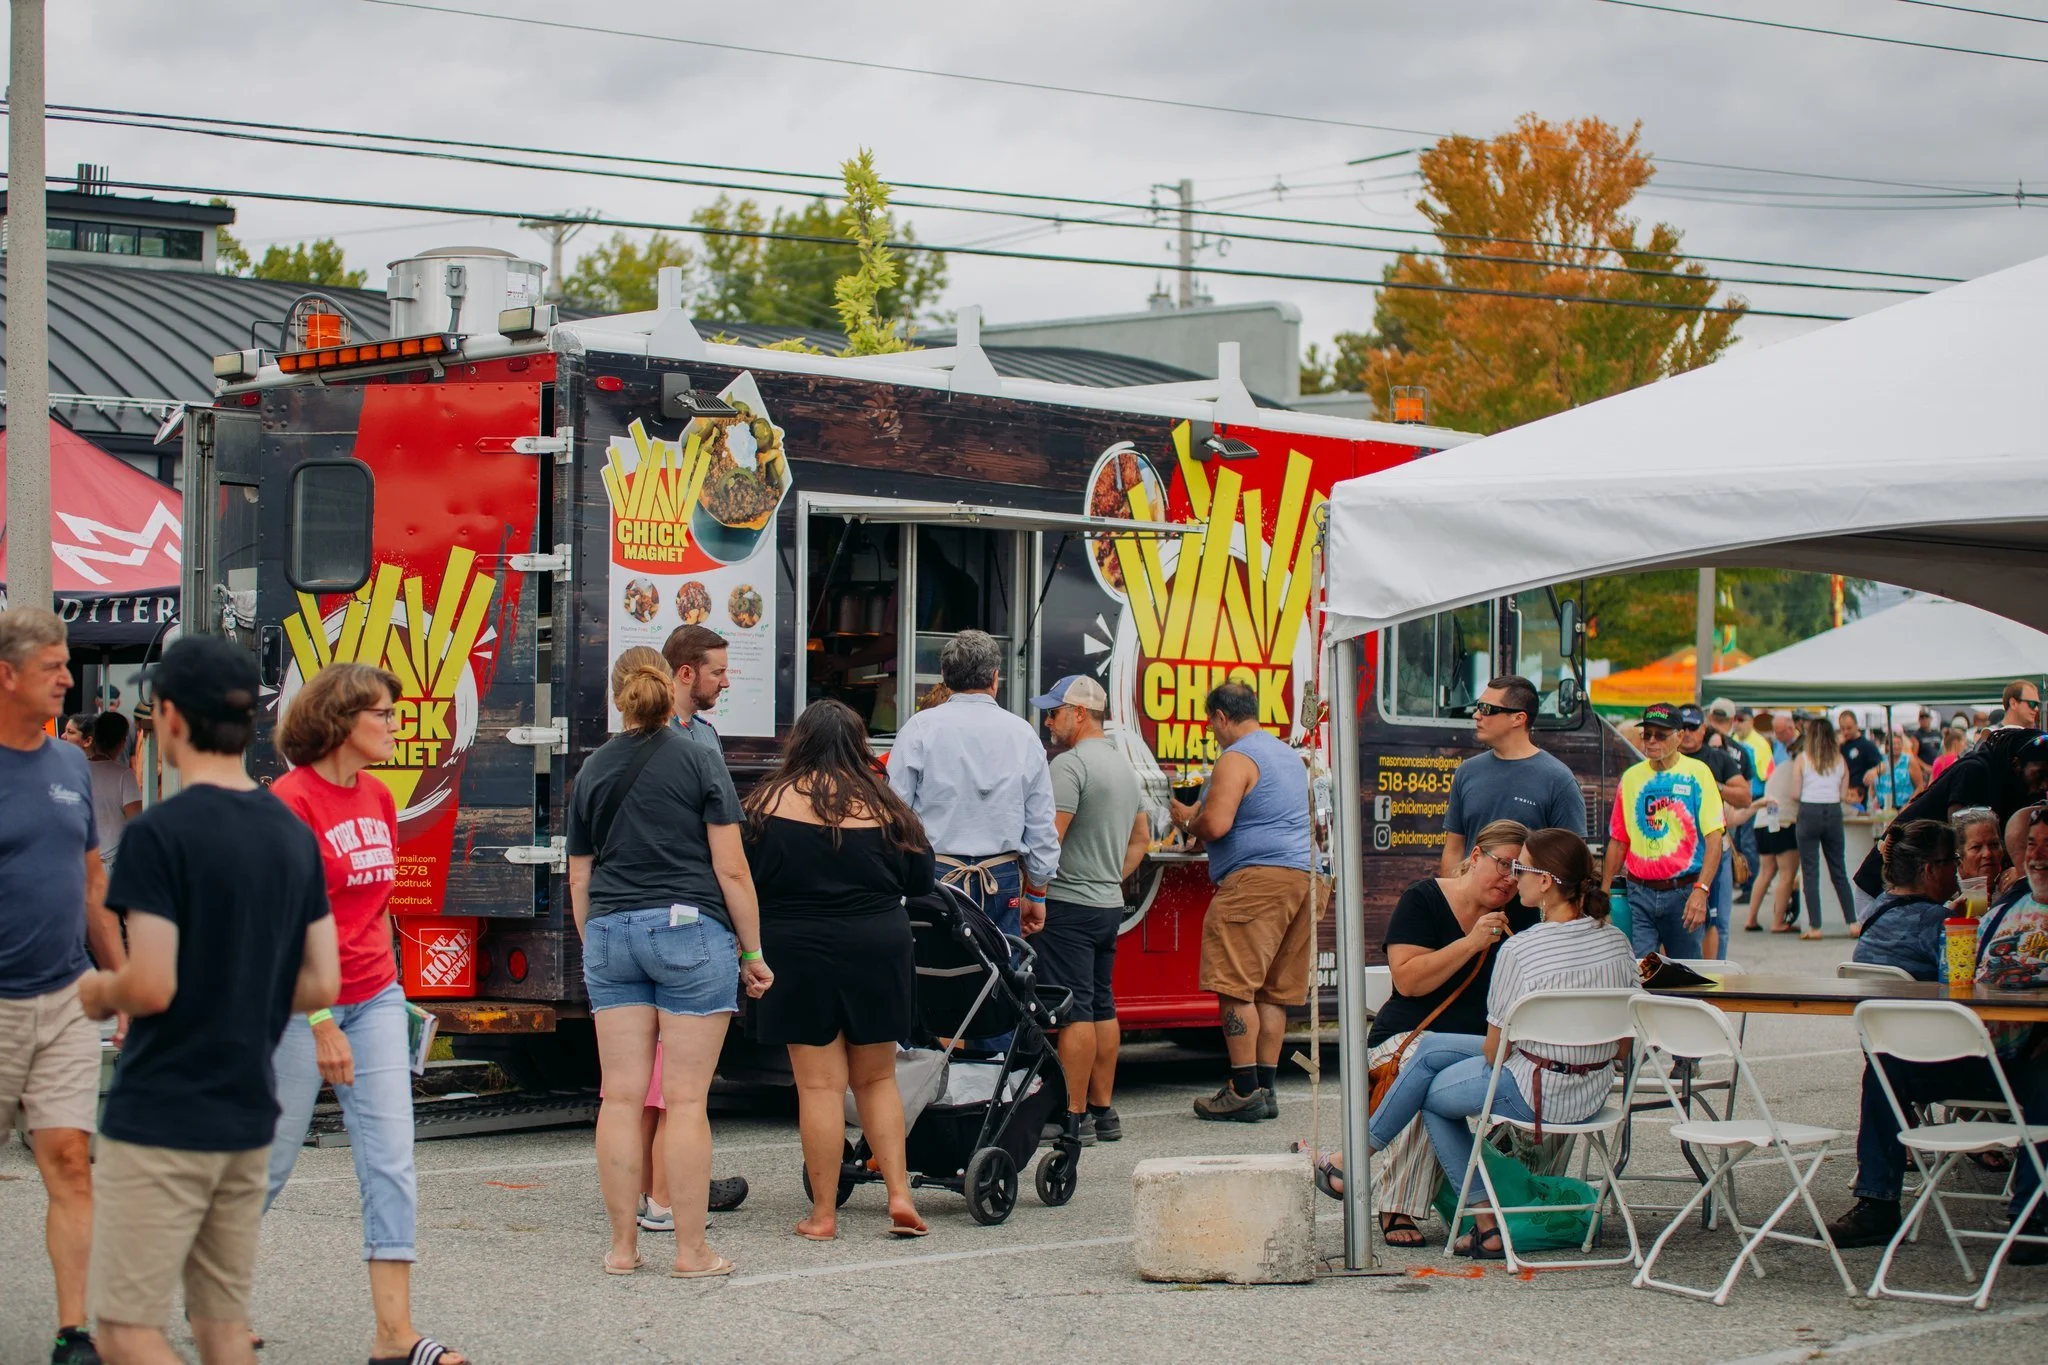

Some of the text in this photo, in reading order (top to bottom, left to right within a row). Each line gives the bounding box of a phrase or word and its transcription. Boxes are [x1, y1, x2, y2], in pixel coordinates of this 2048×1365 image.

[616, 519, 690, 548] CHICK
[623, 544, 685, 563] MAGNET
[1143, 661, 1291, 725] CHK
[324, 819, 362, 858] YORK
[421, 928, 471, 986] HOME
[425, 934, 449, 958] THE
[441, 950, 471, 986] DEPOT
